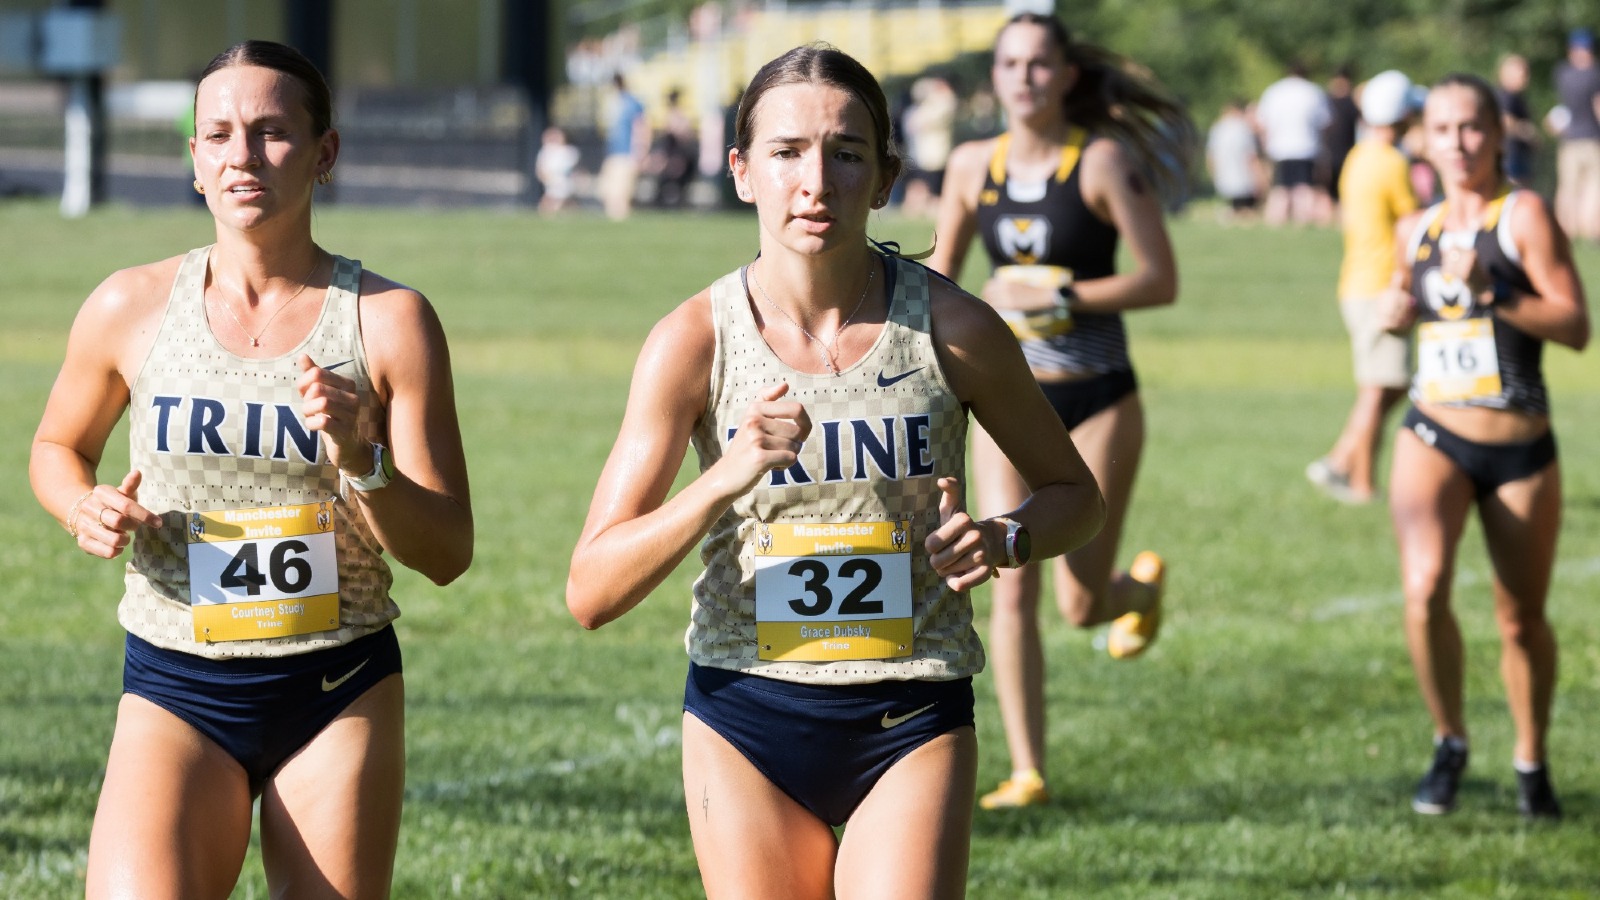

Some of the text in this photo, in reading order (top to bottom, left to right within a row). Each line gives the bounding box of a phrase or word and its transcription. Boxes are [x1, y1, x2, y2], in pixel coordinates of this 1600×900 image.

[1438, 343, 1478, 372] 16
[151, 395, 332, 465] TRIN
[224, 507, 302, 523] Manchester
[245, 525, 283, 538] Invite
[793, 524, 875, 537] Manchester
[814, 542, 854, 554] Invite
[220, 540, 312, 596] 46
[788, 558, 884, 617] 32
[231, 603, 305, 619] Courtney Study
[257, 619, 283, 629] Trine
[800, 625, 871, 639] Grace Dubsky
[822, 641, 850, 650] Trine
